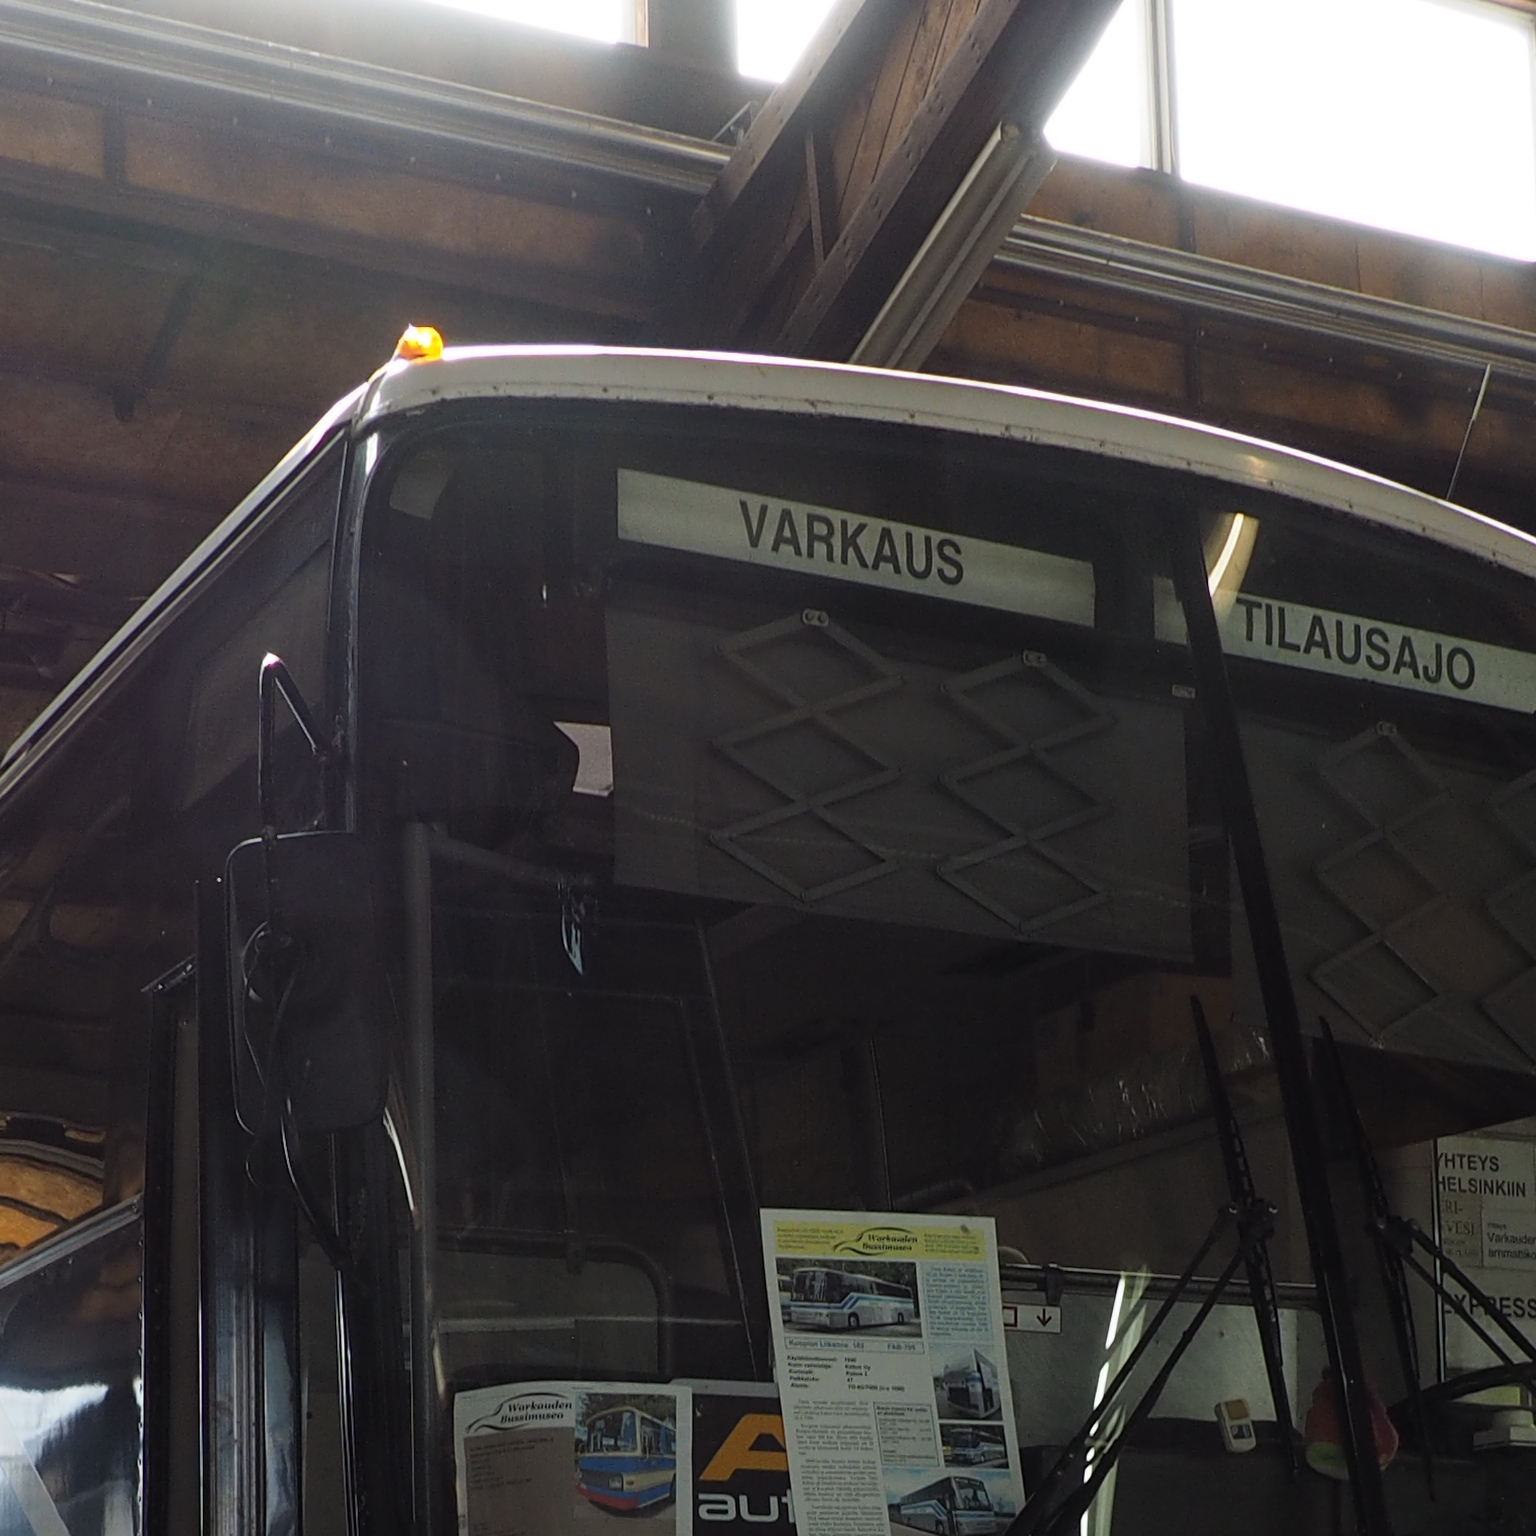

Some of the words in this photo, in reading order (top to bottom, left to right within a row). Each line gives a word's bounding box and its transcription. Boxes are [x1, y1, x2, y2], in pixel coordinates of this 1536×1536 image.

[739, 499, 964, 586] VARKAUS
[1236, 598, 1475, 690] TILAUSAJO
[499, 1411, 564, 1424] Bussimuseo
[508, 1400, 572, 1413] Warkauden
